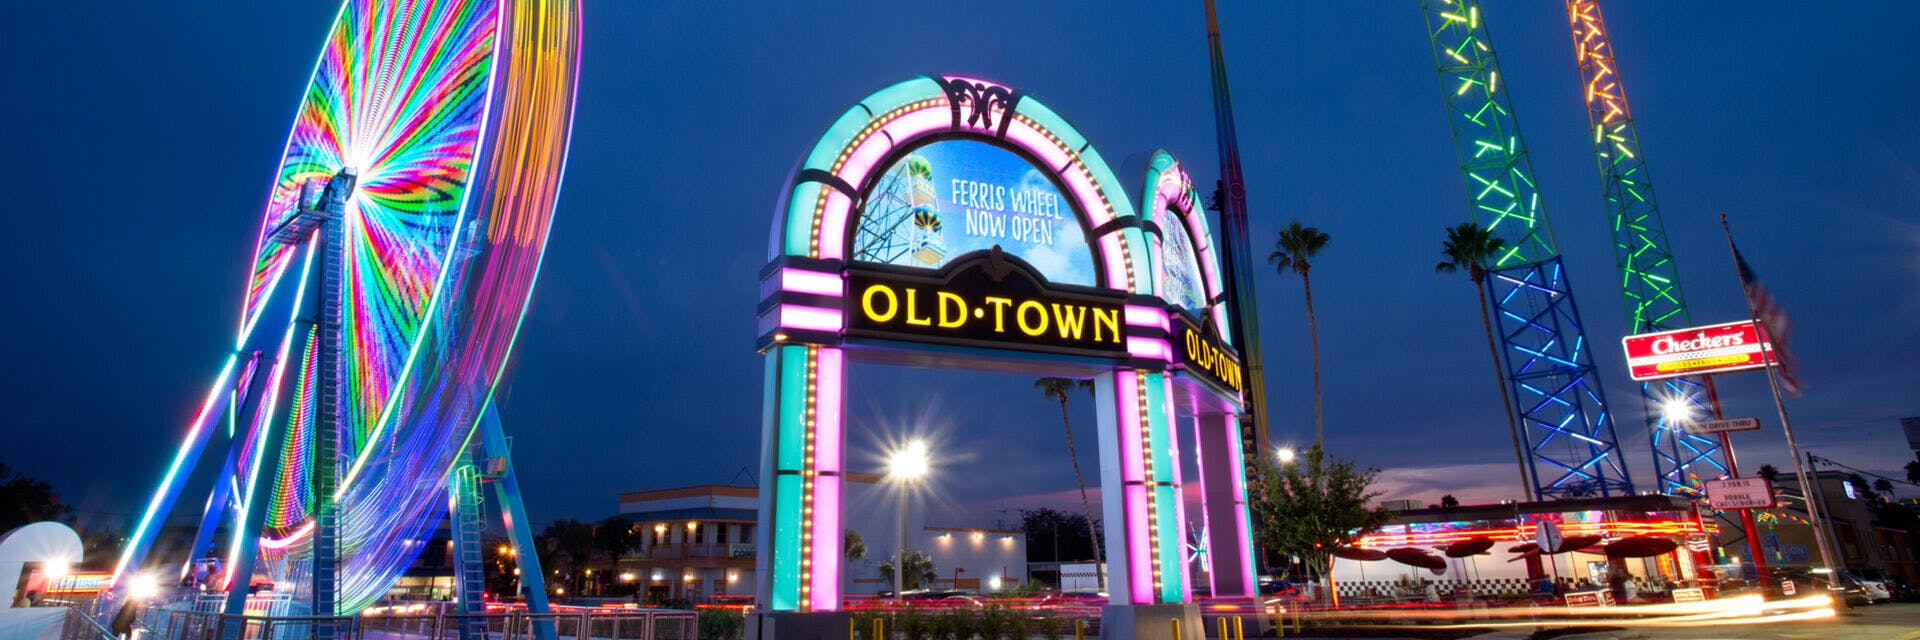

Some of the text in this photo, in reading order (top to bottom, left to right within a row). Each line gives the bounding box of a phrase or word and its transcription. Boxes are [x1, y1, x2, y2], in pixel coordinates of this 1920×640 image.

[952, 178, 1005, 211] FERRIS
[1010, 188, 1064, 220] WHEEL
[966, 208, 1053, 246] NOW OPEN
[1651, 332, 1743, 355] Checkers
[1731, 419, 1751, 427] THRU
